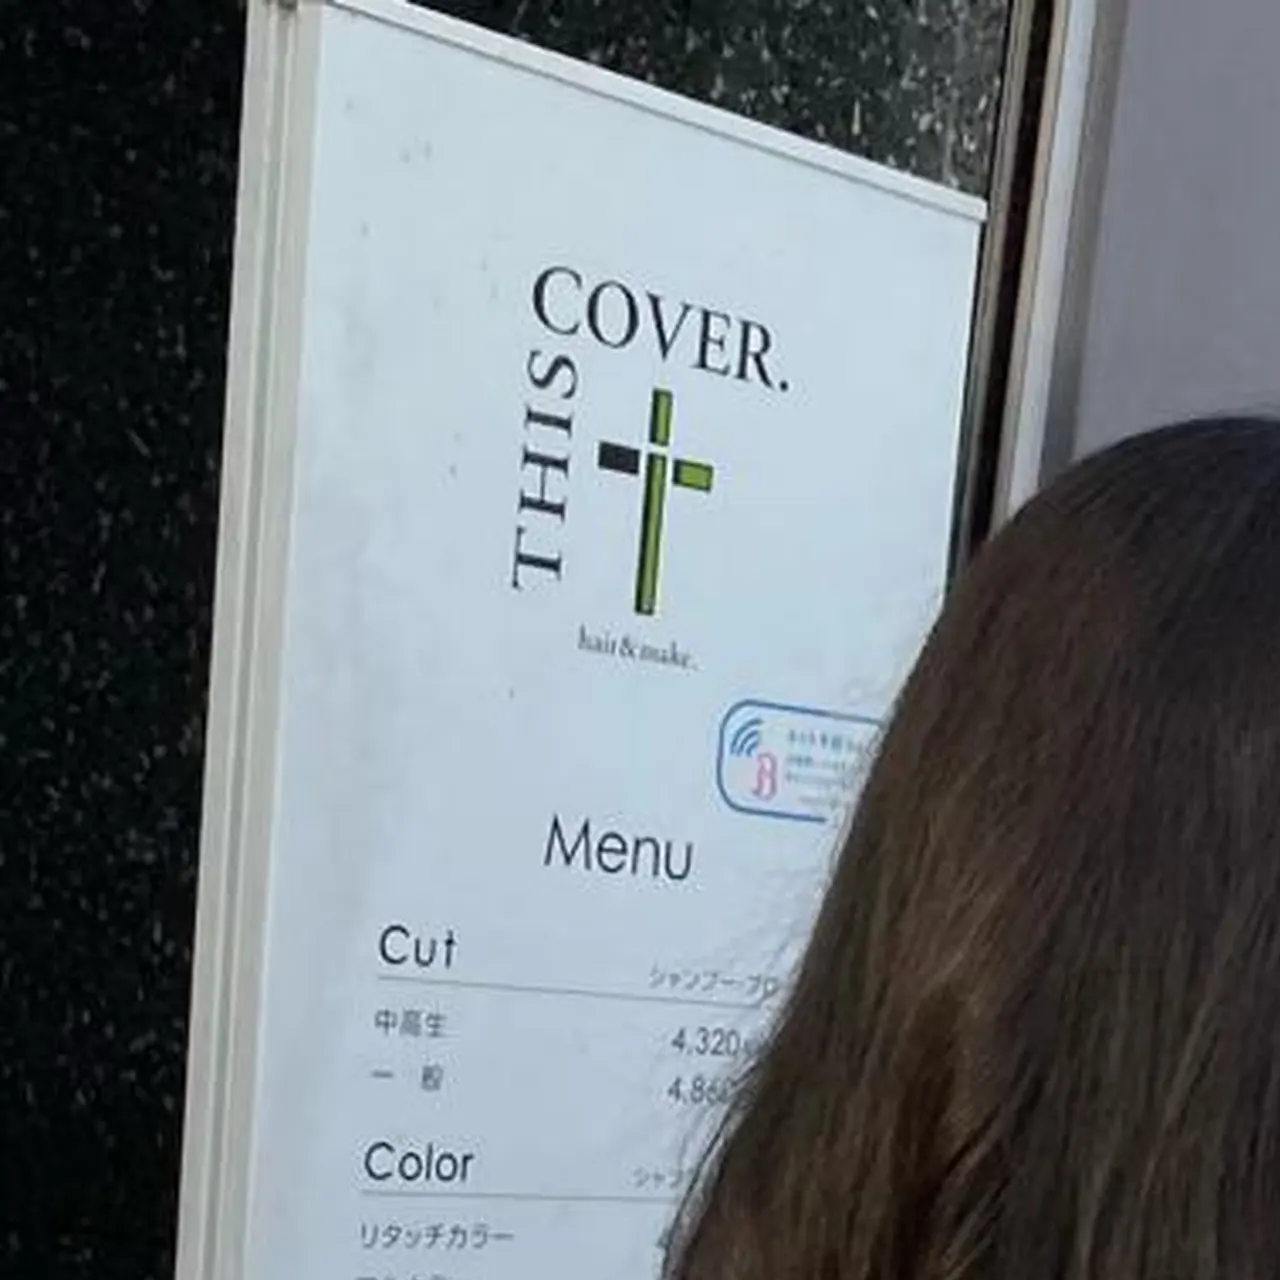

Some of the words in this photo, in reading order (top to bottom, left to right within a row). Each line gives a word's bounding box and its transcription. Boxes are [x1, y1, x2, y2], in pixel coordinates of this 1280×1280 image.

[532, 266, 790, 392] COVER.
[512, 349, 579, 590] THIS
[543, 813, 694, 881] Menu
[378, 924, 458, 968] Cut
[363, 1140, 476, 1183] Color
[358, 1222, 515, 1250] リタッチカラー
